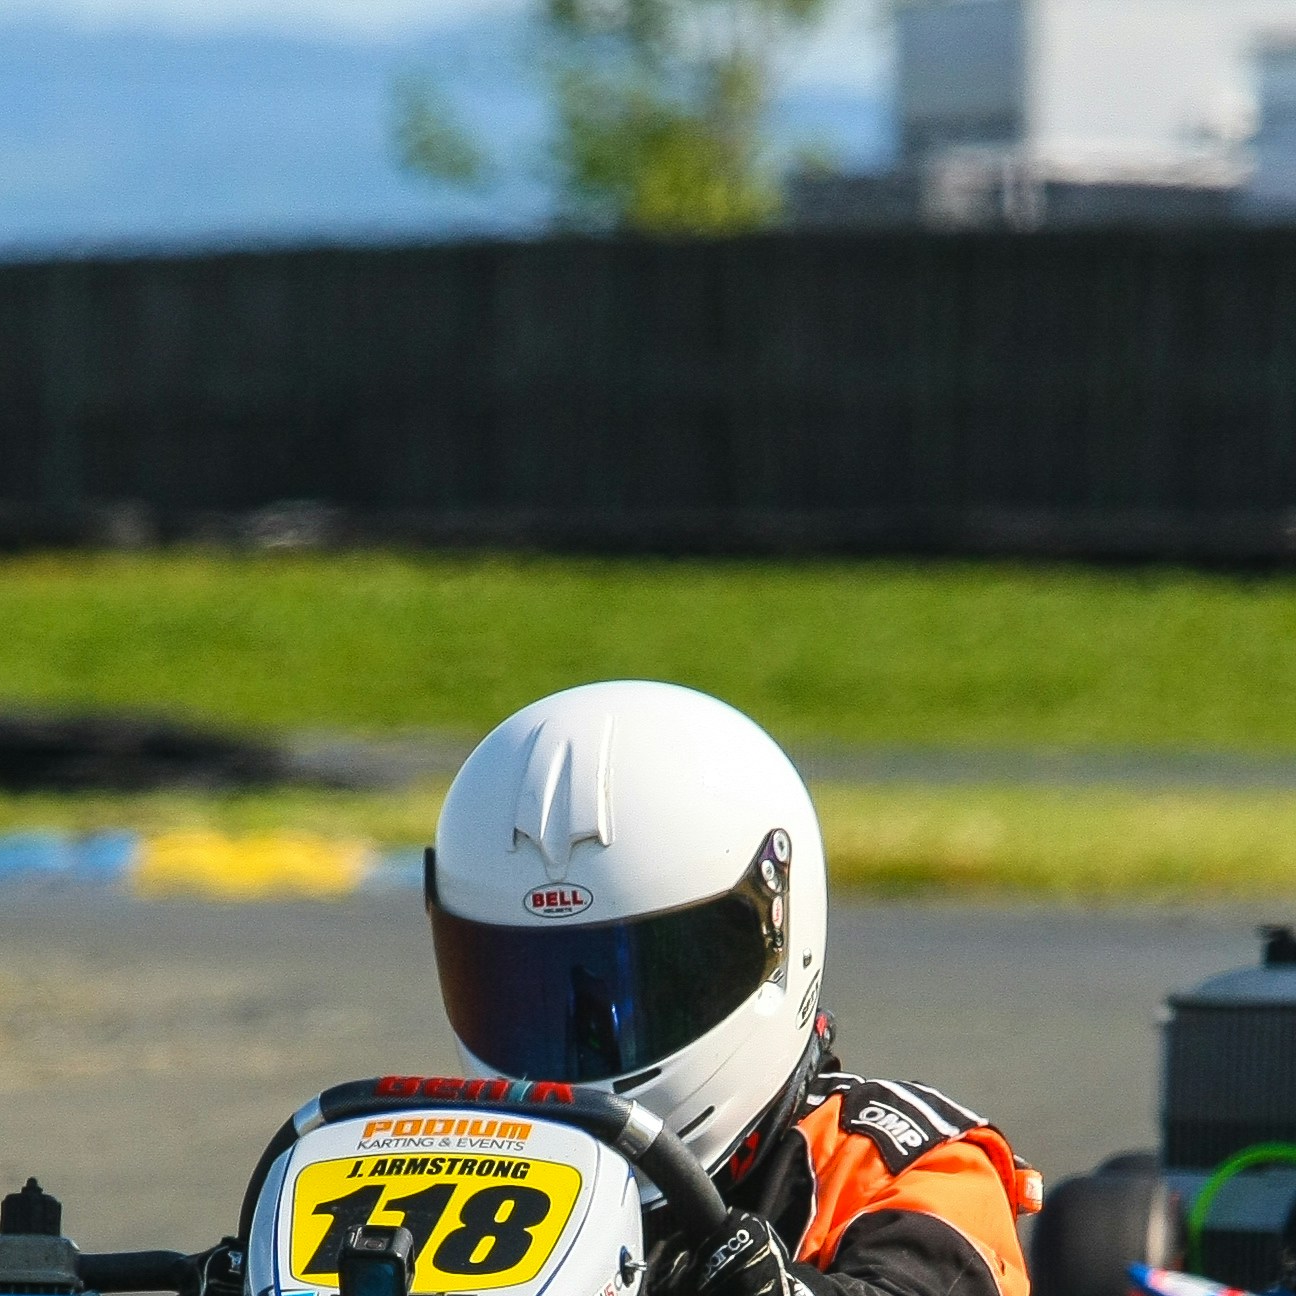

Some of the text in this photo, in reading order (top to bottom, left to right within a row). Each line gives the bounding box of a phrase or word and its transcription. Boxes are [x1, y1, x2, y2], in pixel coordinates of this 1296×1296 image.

[531, 889, 584, 908] BELL
[362, 1119, 533, 1141] PODIUM
[859, 1106, 923, 1147] OMP
[357, 1136, 525, 1151] KARTING & EVENTS
[347, 1157, 531, 1180] J. ARMSTRONG
[301, 1183, 551, 1276] 118
